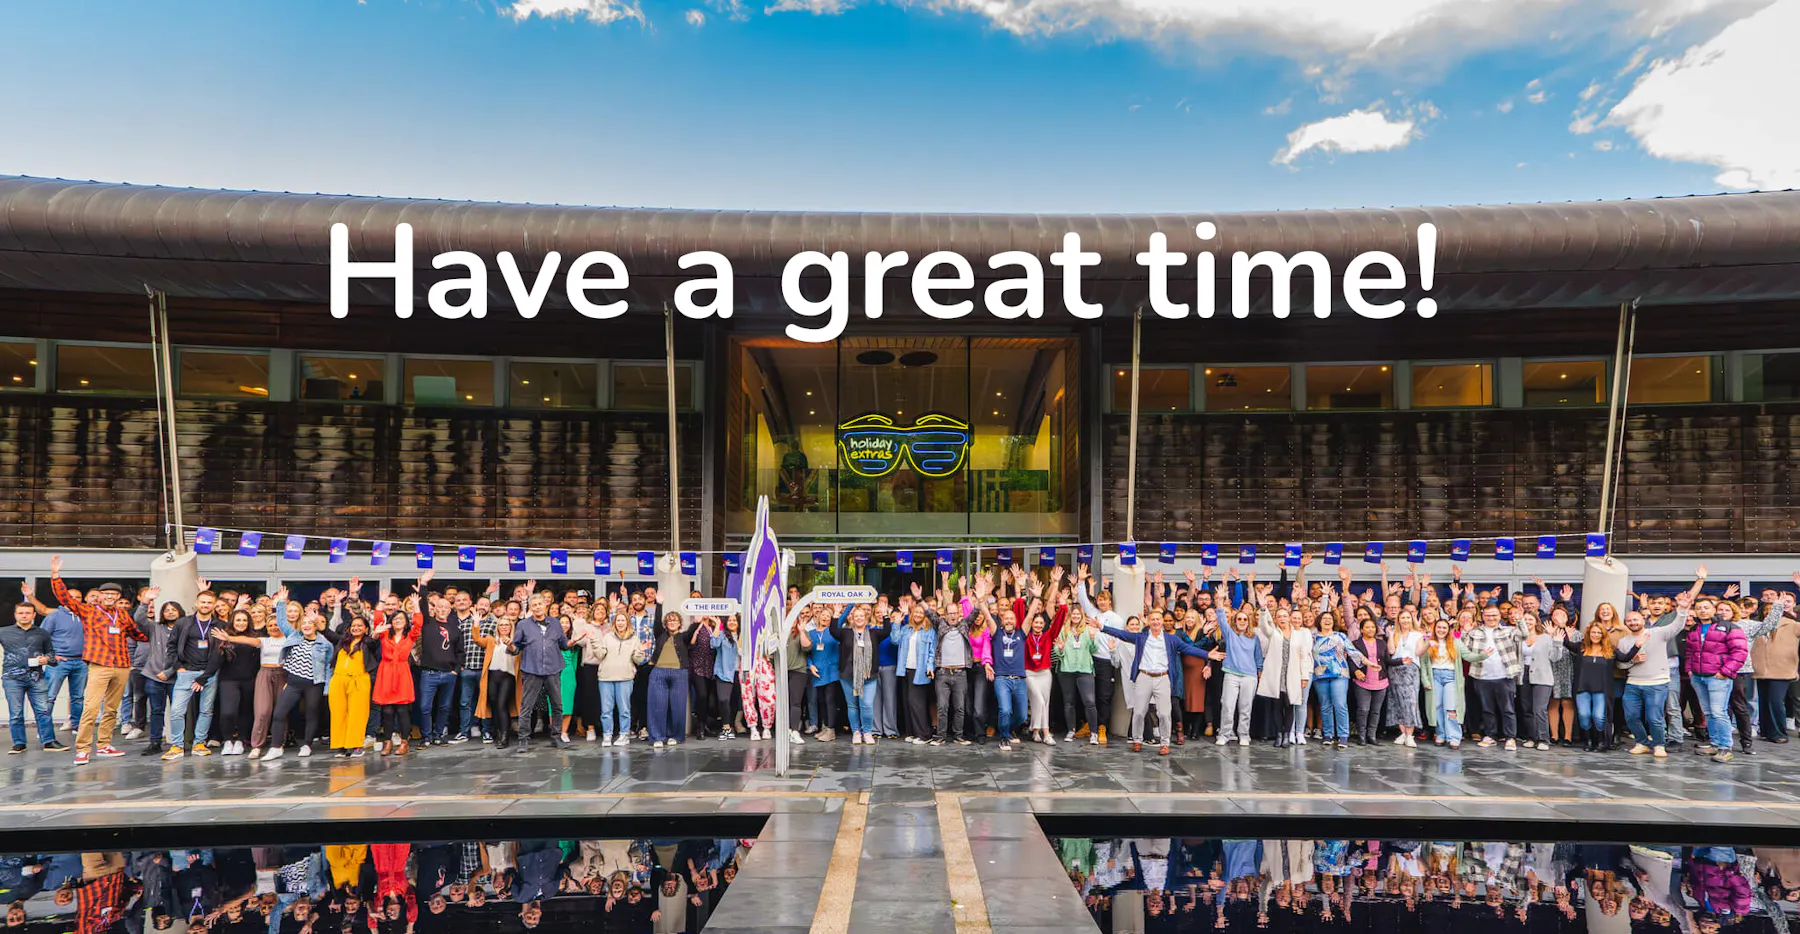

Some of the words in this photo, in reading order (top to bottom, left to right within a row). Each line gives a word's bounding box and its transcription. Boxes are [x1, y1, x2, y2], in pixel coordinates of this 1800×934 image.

[850, 437, 893, 451] holiday
[850, 449, 893, 459] extras
[694, 603, 710, 611] THE
[710, 603, 729, 611] REEF
